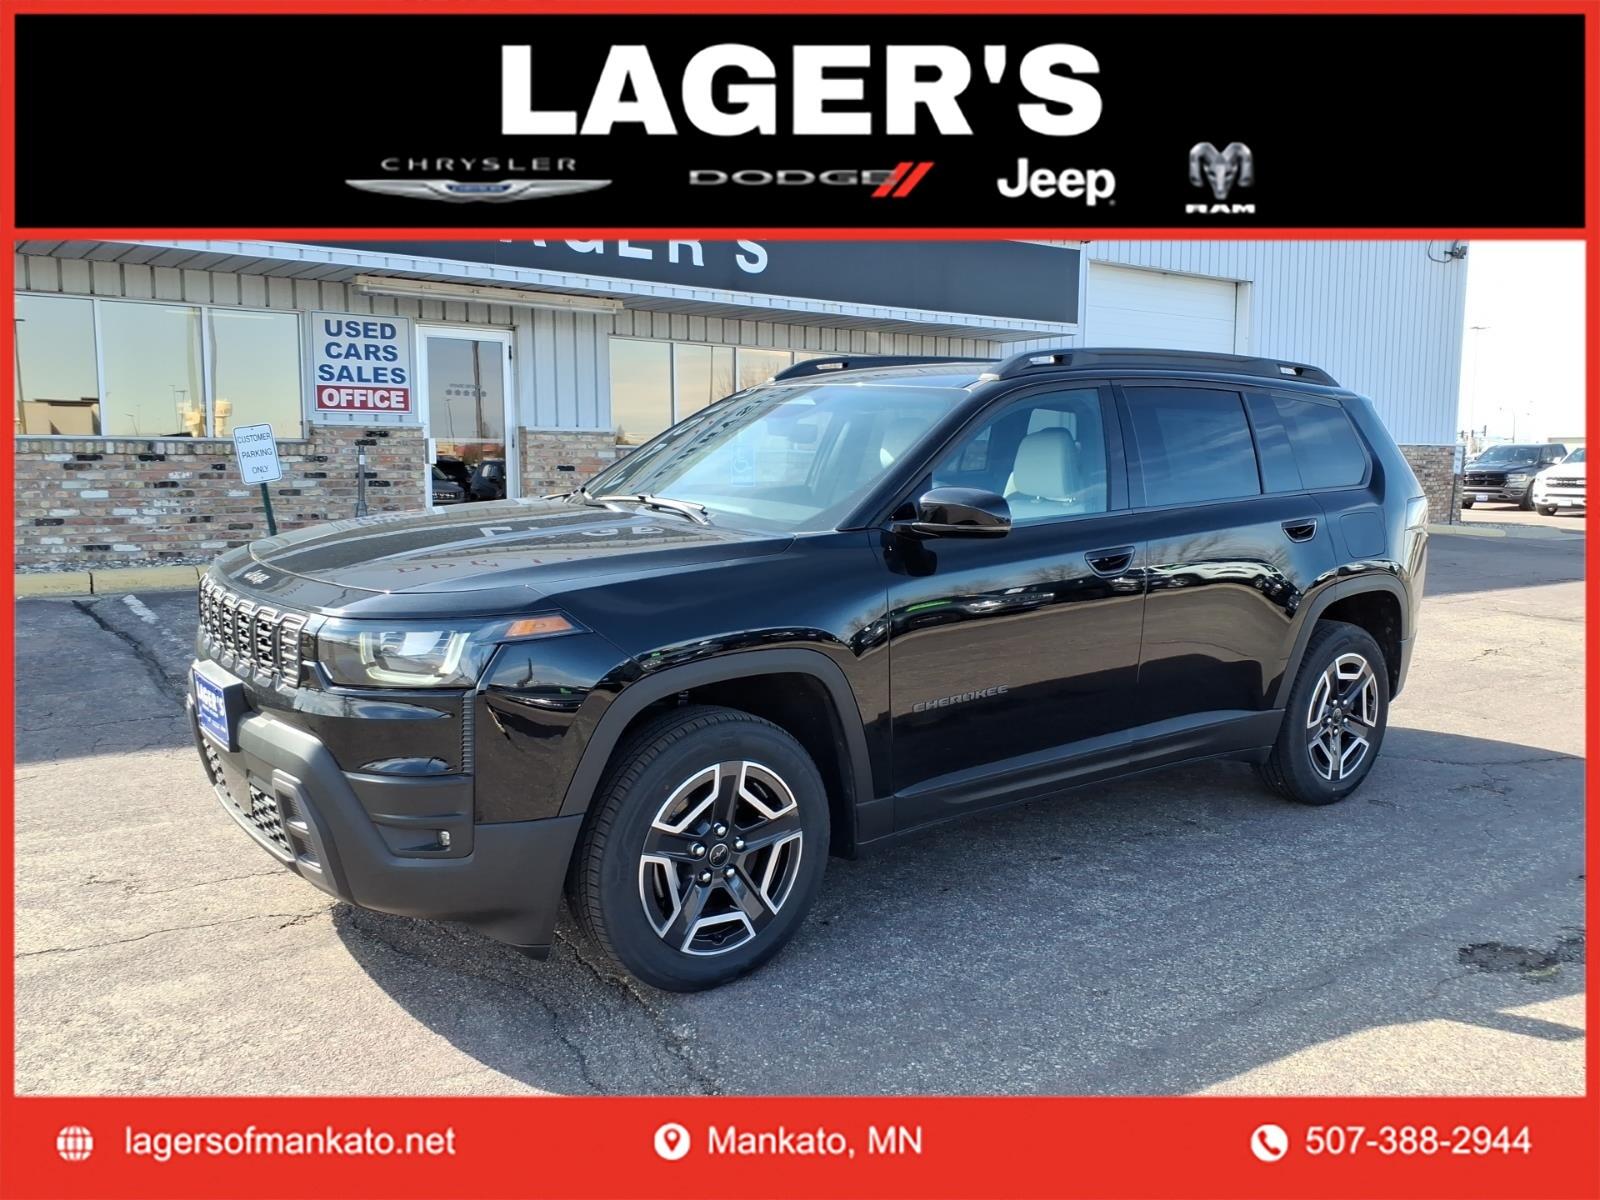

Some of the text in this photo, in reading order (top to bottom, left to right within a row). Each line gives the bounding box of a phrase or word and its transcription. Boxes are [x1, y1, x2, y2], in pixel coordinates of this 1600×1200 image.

[324, 319, 397, 340] USED
[325, 341, 398, 363] CARS
[317, 363, 407, 385] SALES
[322, 388, 405, 409] OFFICE
[237, 432, 271, 444] CUSTOMER
[241, 447, 273, 459] PARKING
[251, 464, 269, 474] ONLY
[912, 684, 1009, 713] CHEROKEE
